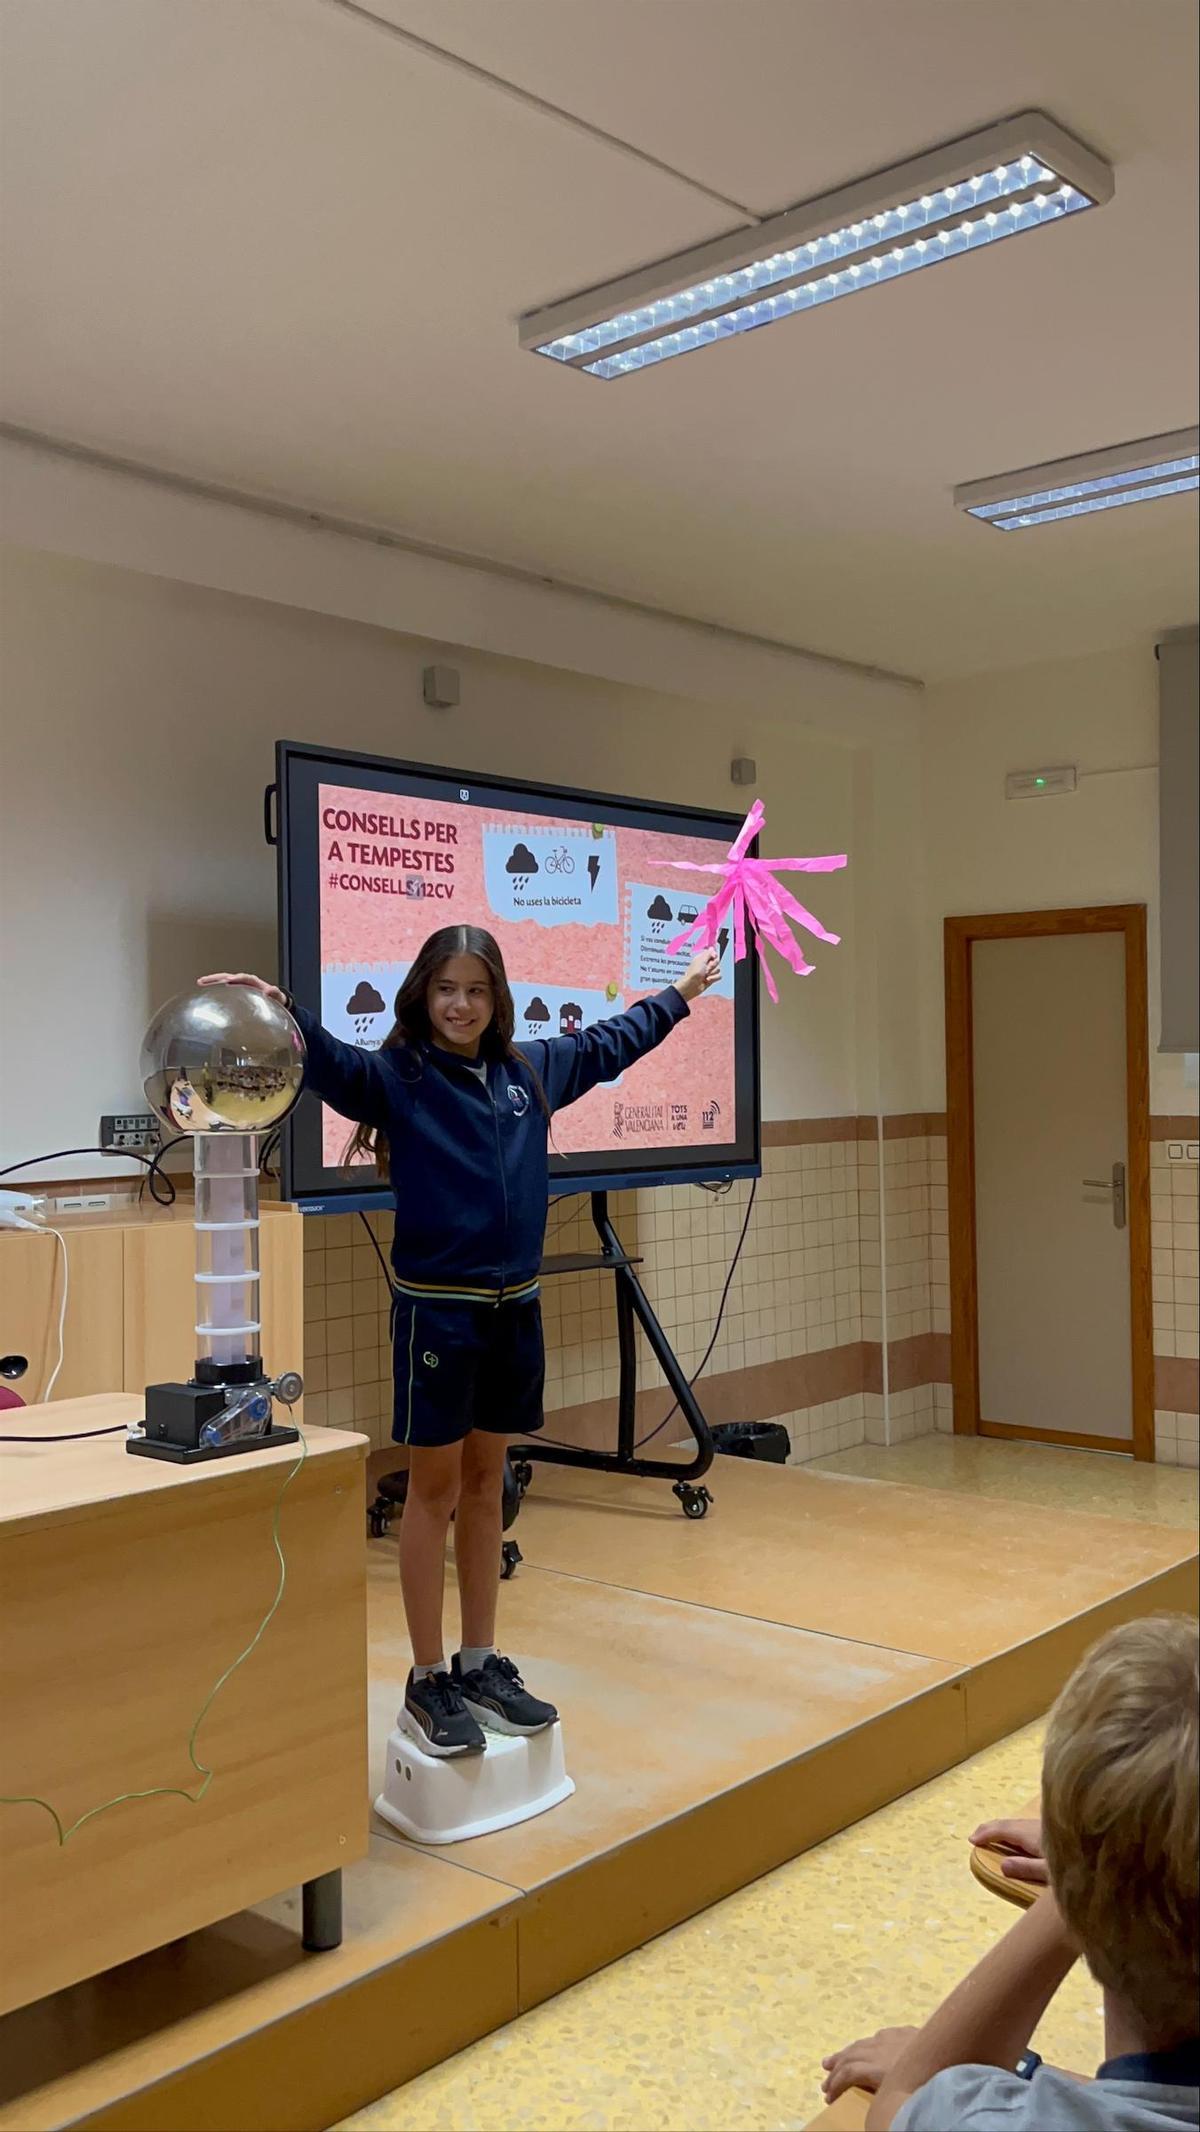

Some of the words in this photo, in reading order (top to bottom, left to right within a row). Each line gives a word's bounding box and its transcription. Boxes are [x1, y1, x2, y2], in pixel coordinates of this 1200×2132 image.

[323, 807, 420, 840] CONSELLS
[425, 821, 458, 844] PER
[328, 841, 343, 862] A
[347, 842, 454, 874] TEMPESTES
[513, 897, 525, 906] No
[526, 899, 543, 907] uses
[543, 896, 550, 906] la
[551, 896, 582, 906] bicicleta
[625, 1104, 663, 1120] GENERALITAT
[671, 1104, 687, 1113] TOTS
[702, 1111, 714, 1121] 112
[625, 1119, 664, 1132] VALENCIANA
